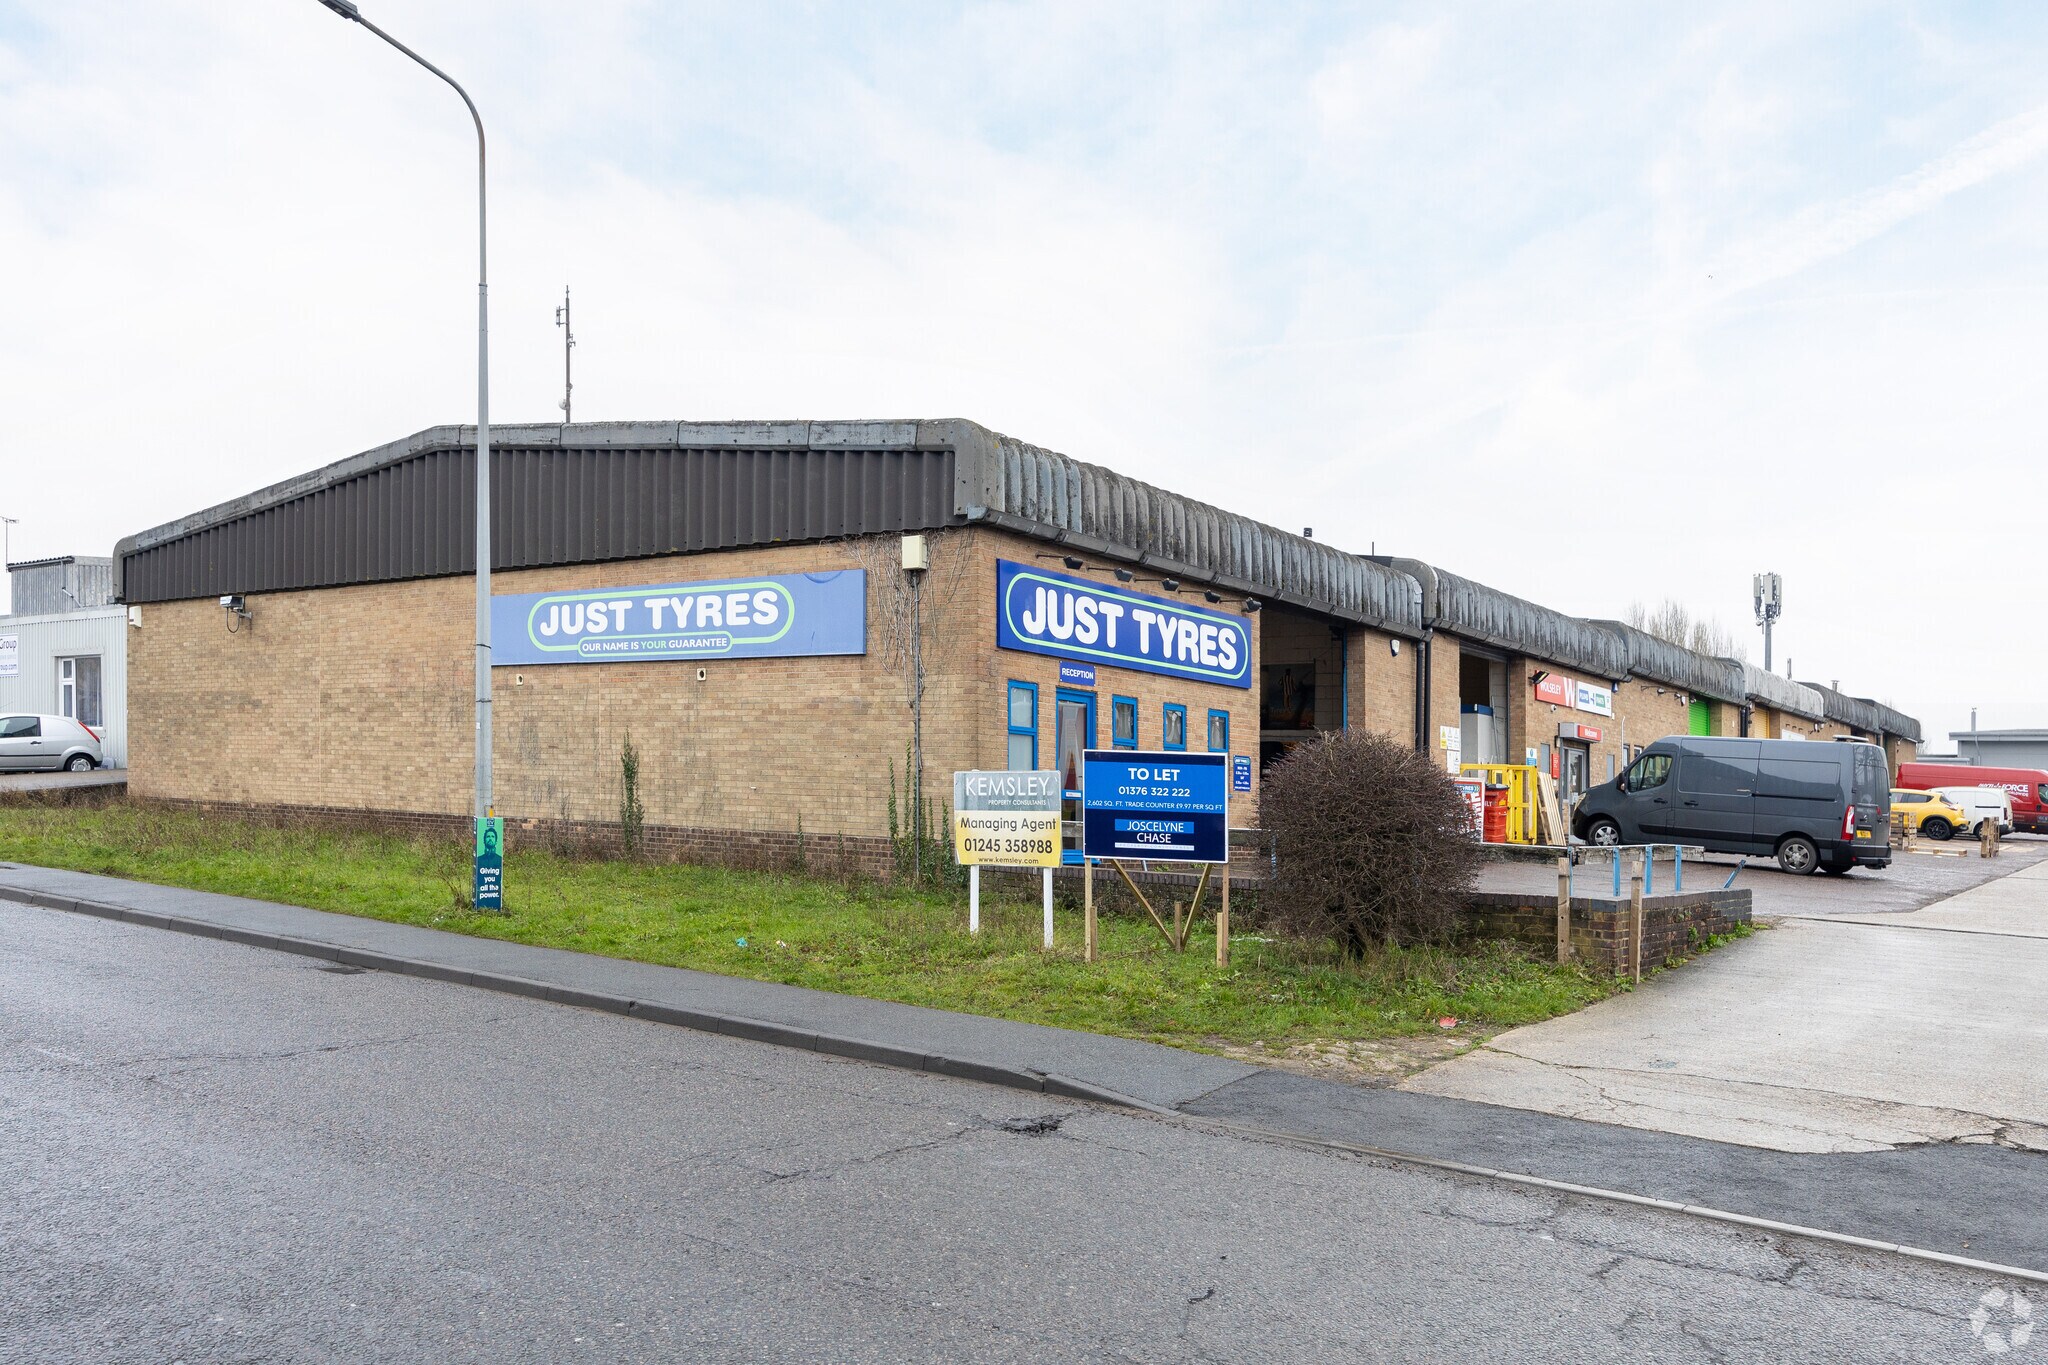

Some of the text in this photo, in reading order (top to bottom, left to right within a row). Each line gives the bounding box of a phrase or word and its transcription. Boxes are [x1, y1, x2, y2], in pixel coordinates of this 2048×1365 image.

[540, 590, 779, 636] JUST TYRES
[1022, 586, 1237, 671] JUST TYRES
[582, 638, 727, 652] OUR NAME IS YOUR GUARANTEE
[1061, 667, 1094, 680] RECEPTION
[1540, 682, 1561, 695] WOLSELEY
[1128, 768, 1180, 781] TO LET
[966, 777, 1050, 796] KEMSLEY
[1118, 786, 1190, 797] 01376 322 222
[960, 817, 1057, 832] Managing Agent
[1126, 821, 1184, 832] JOSCELYNE
[1136, 832, 1172, 844] CHASE
[964, 838, 1053, 854] 01245 358988
[978, 857, 1039, 865] www.kemsley.com
[479, 868, 500, 876] Giving
[484, 876, 496, 884] you
[479, 891, 500, 899] power.
